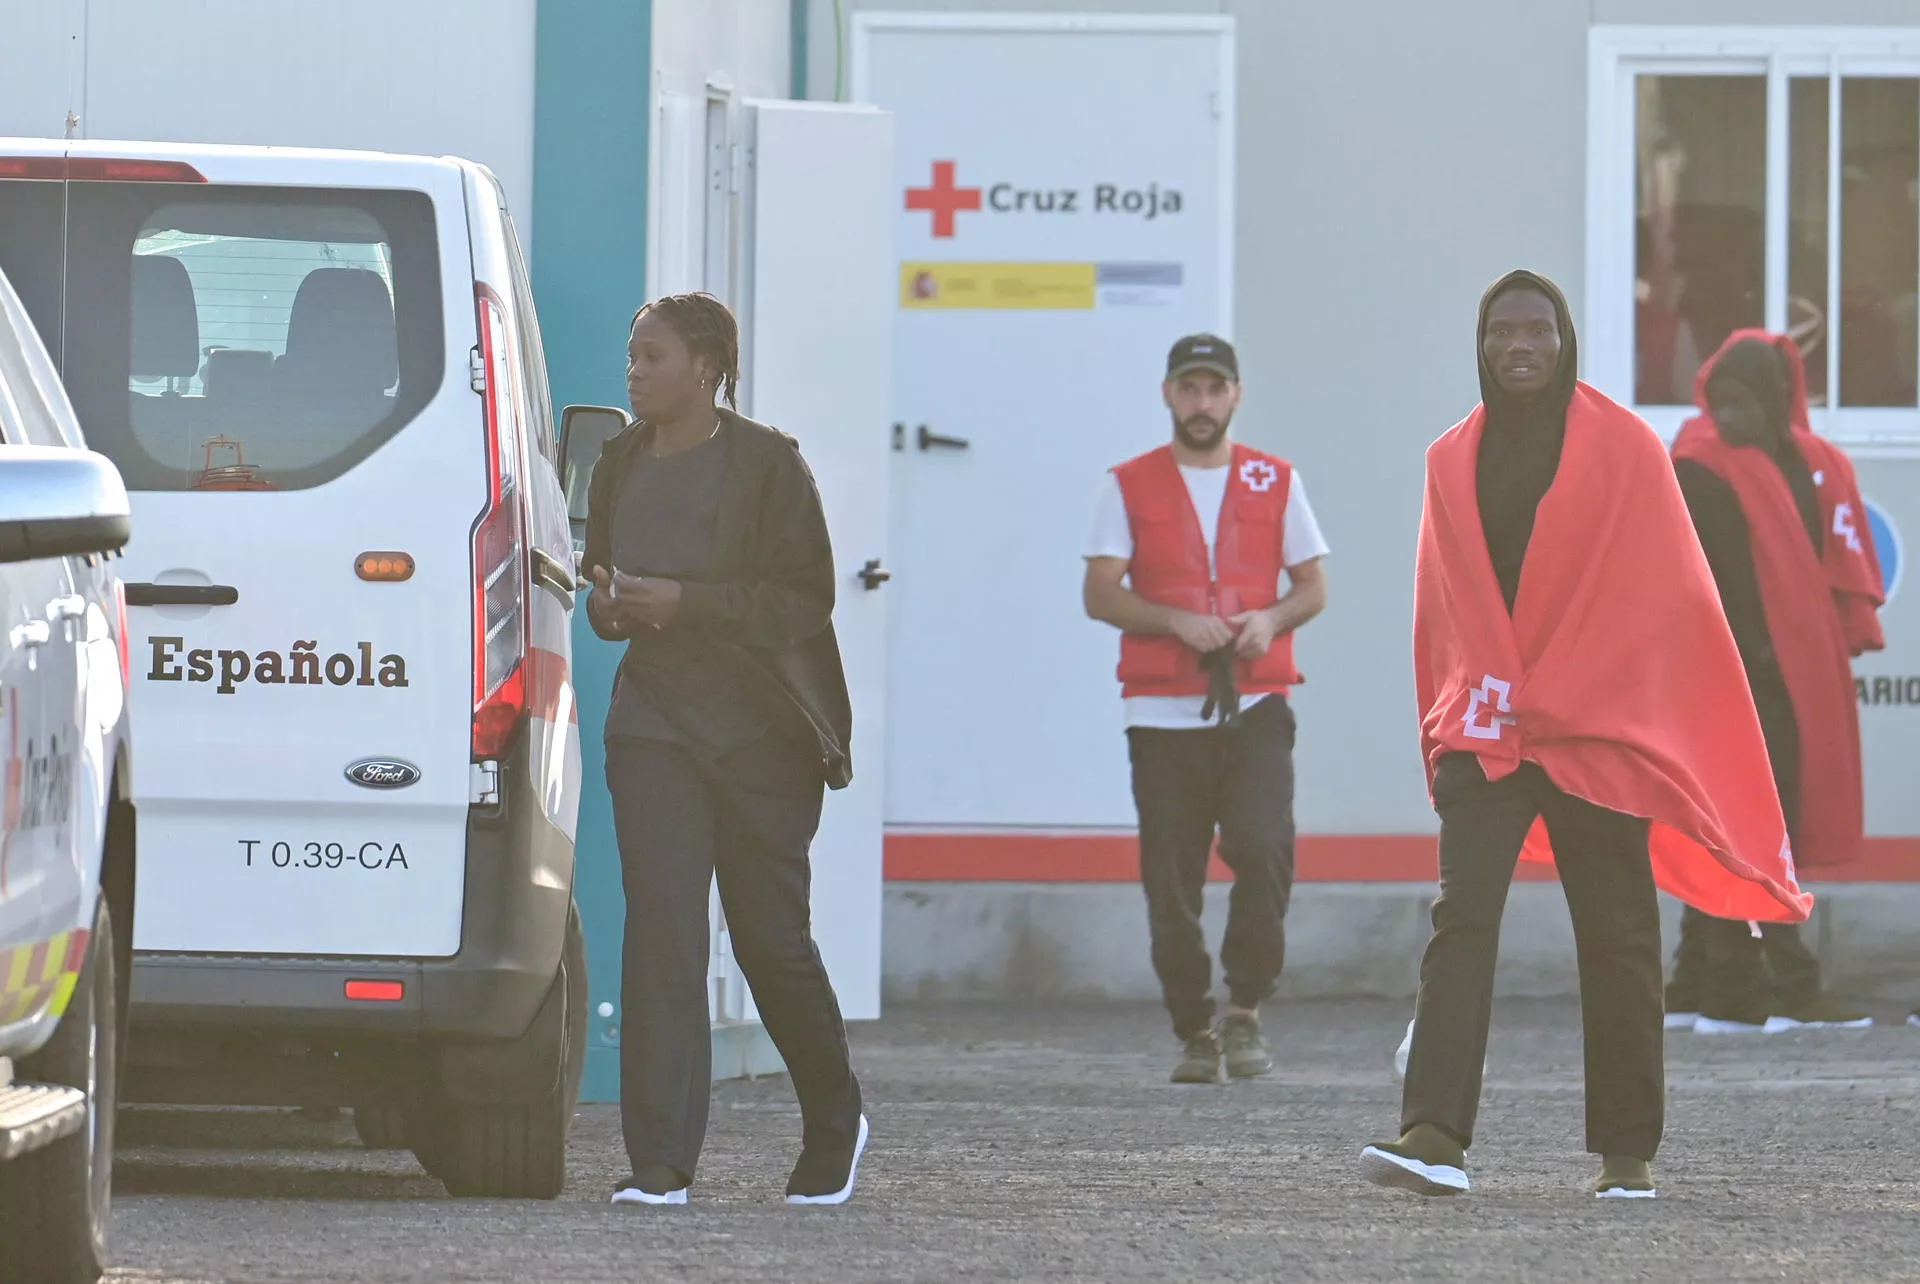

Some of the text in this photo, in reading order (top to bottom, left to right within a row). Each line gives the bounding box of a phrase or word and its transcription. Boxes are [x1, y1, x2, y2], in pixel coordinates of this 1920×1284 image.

[988, 183, 1184, 221] Cruz Roja
[147, 636, 409, 695] Española
[362, 763, 406, 782] Ford
[238, 839, 409, 871] T 0.39-CA
